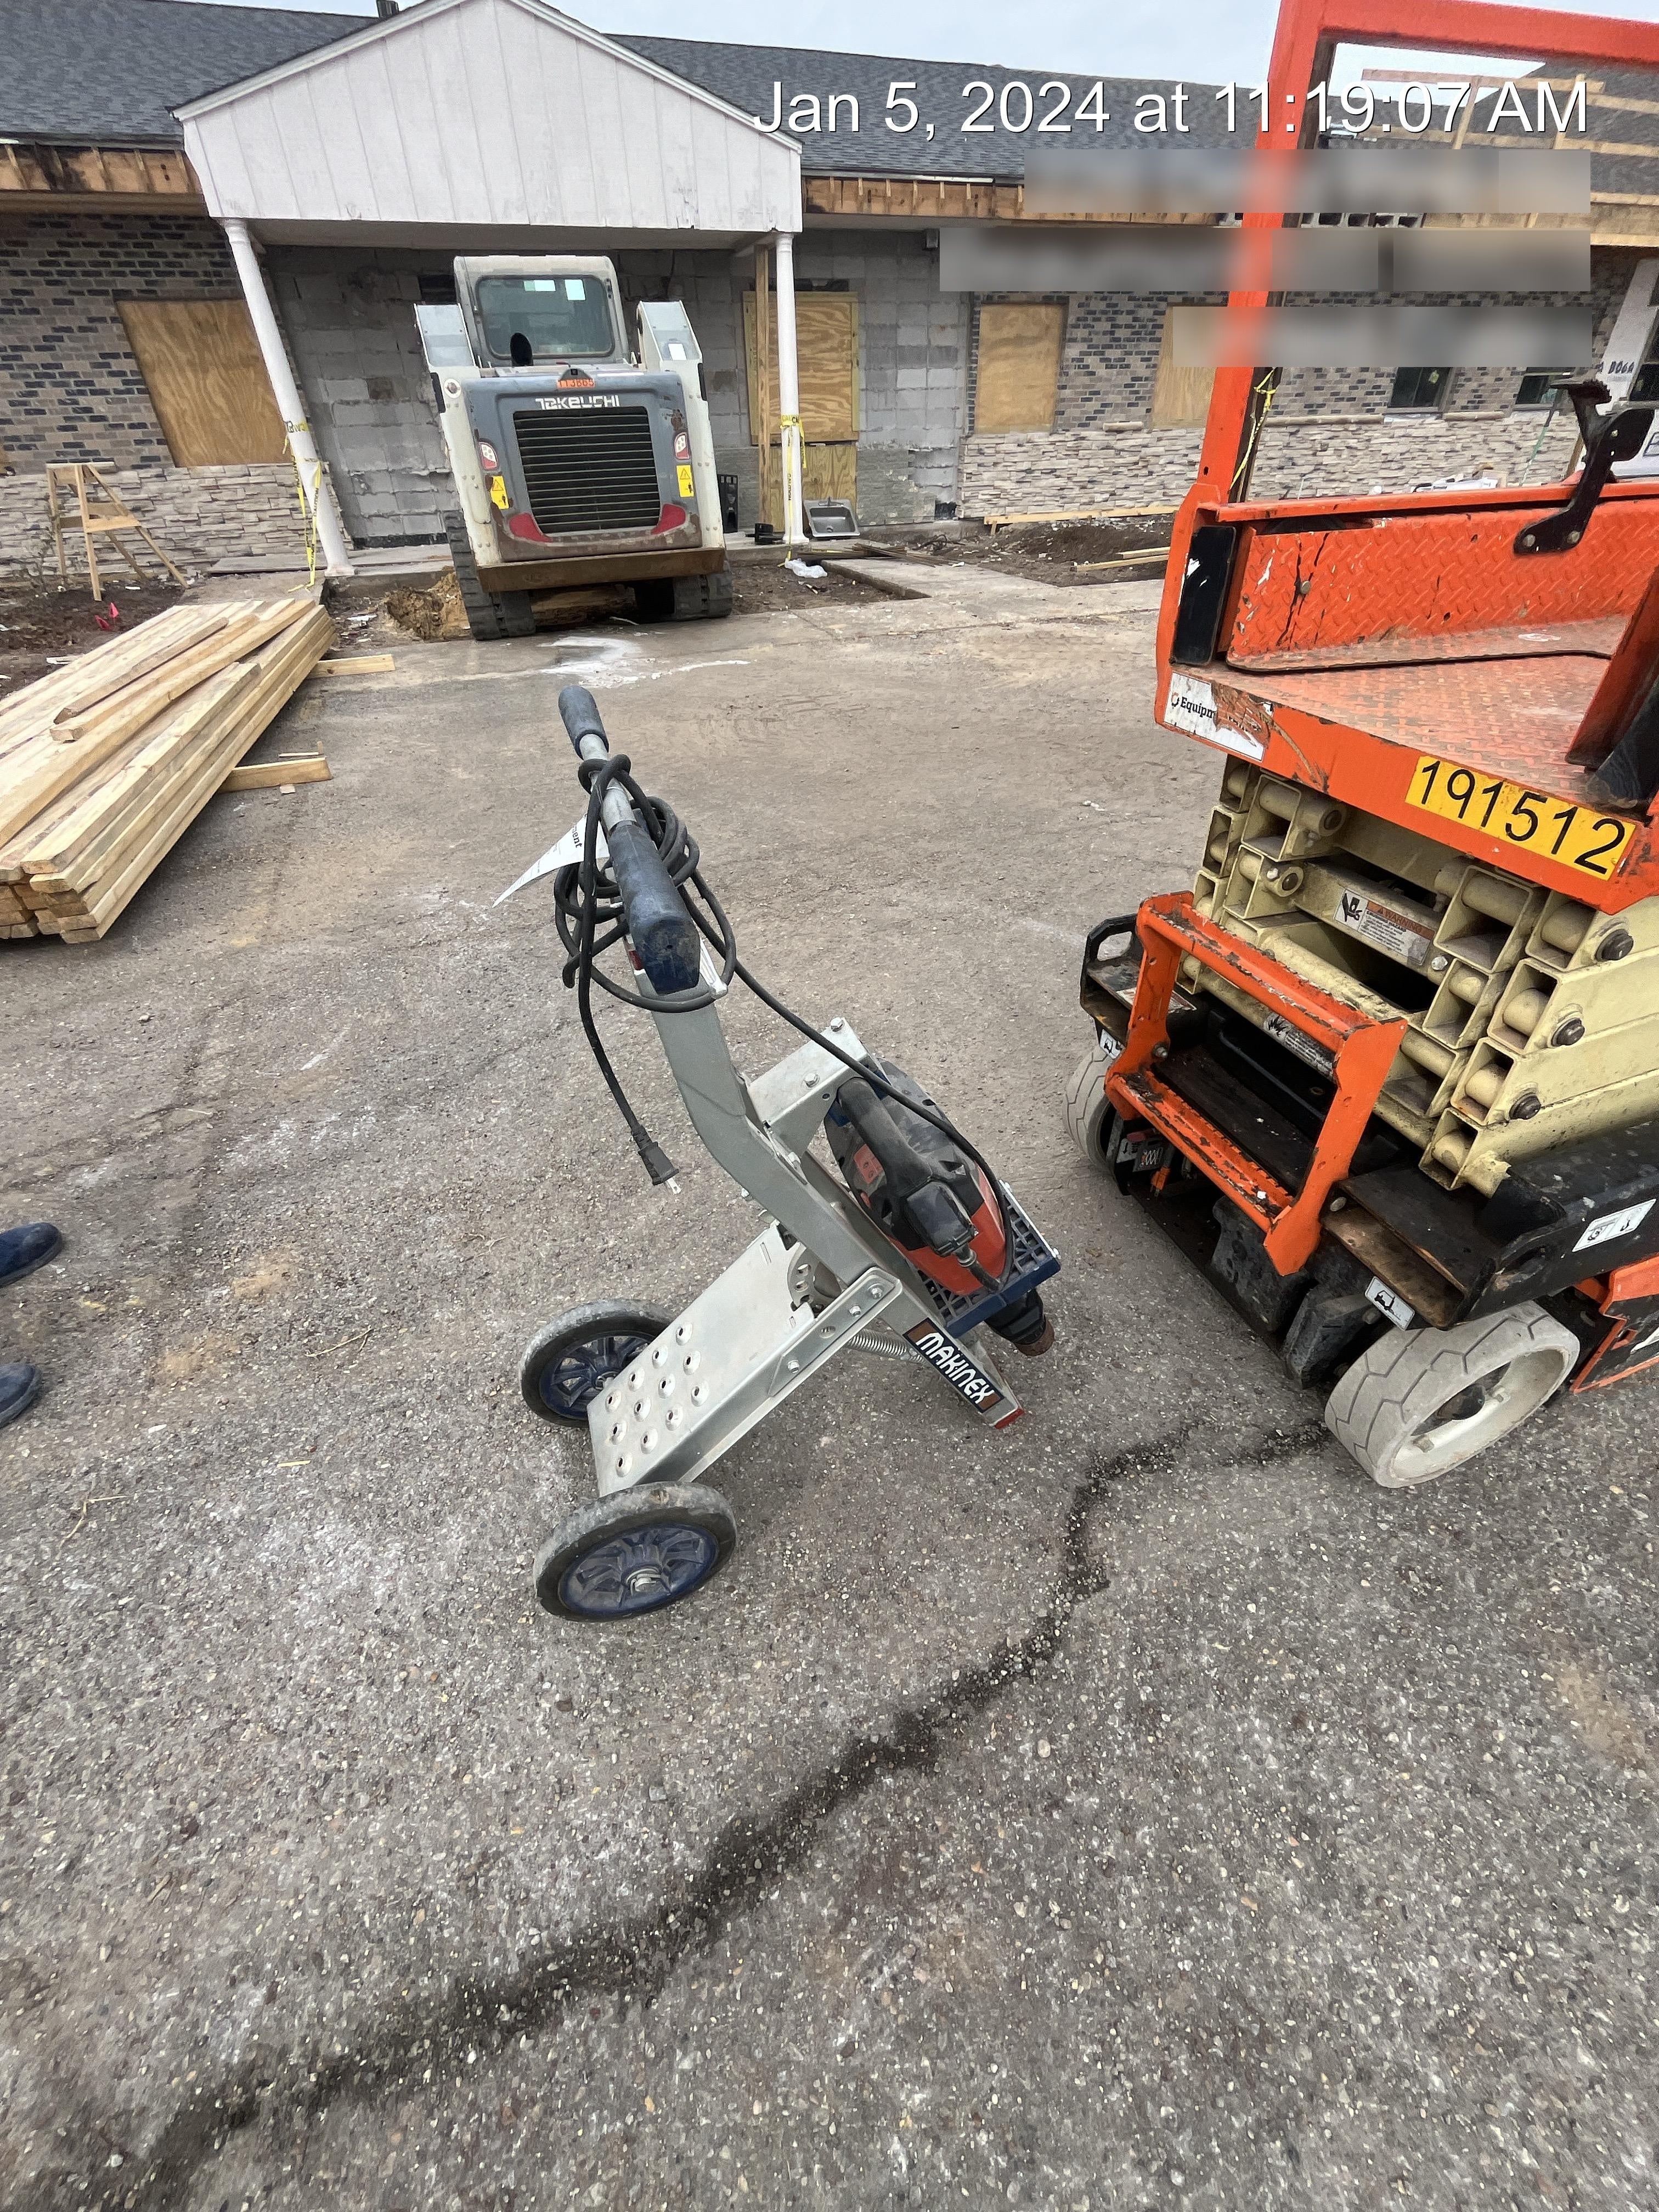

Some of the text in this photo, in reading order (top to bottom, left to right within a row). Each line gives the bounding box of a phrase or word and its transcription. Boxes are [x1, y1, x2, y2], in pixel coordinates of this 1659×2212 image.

[535, 395, 620, 410] TAKEUCHI
[1421, 760, 1625, 875] 191512
[1385, 907, 1423, 933] WARNING
[916, 1332, 995, 1404] MAKINEX
